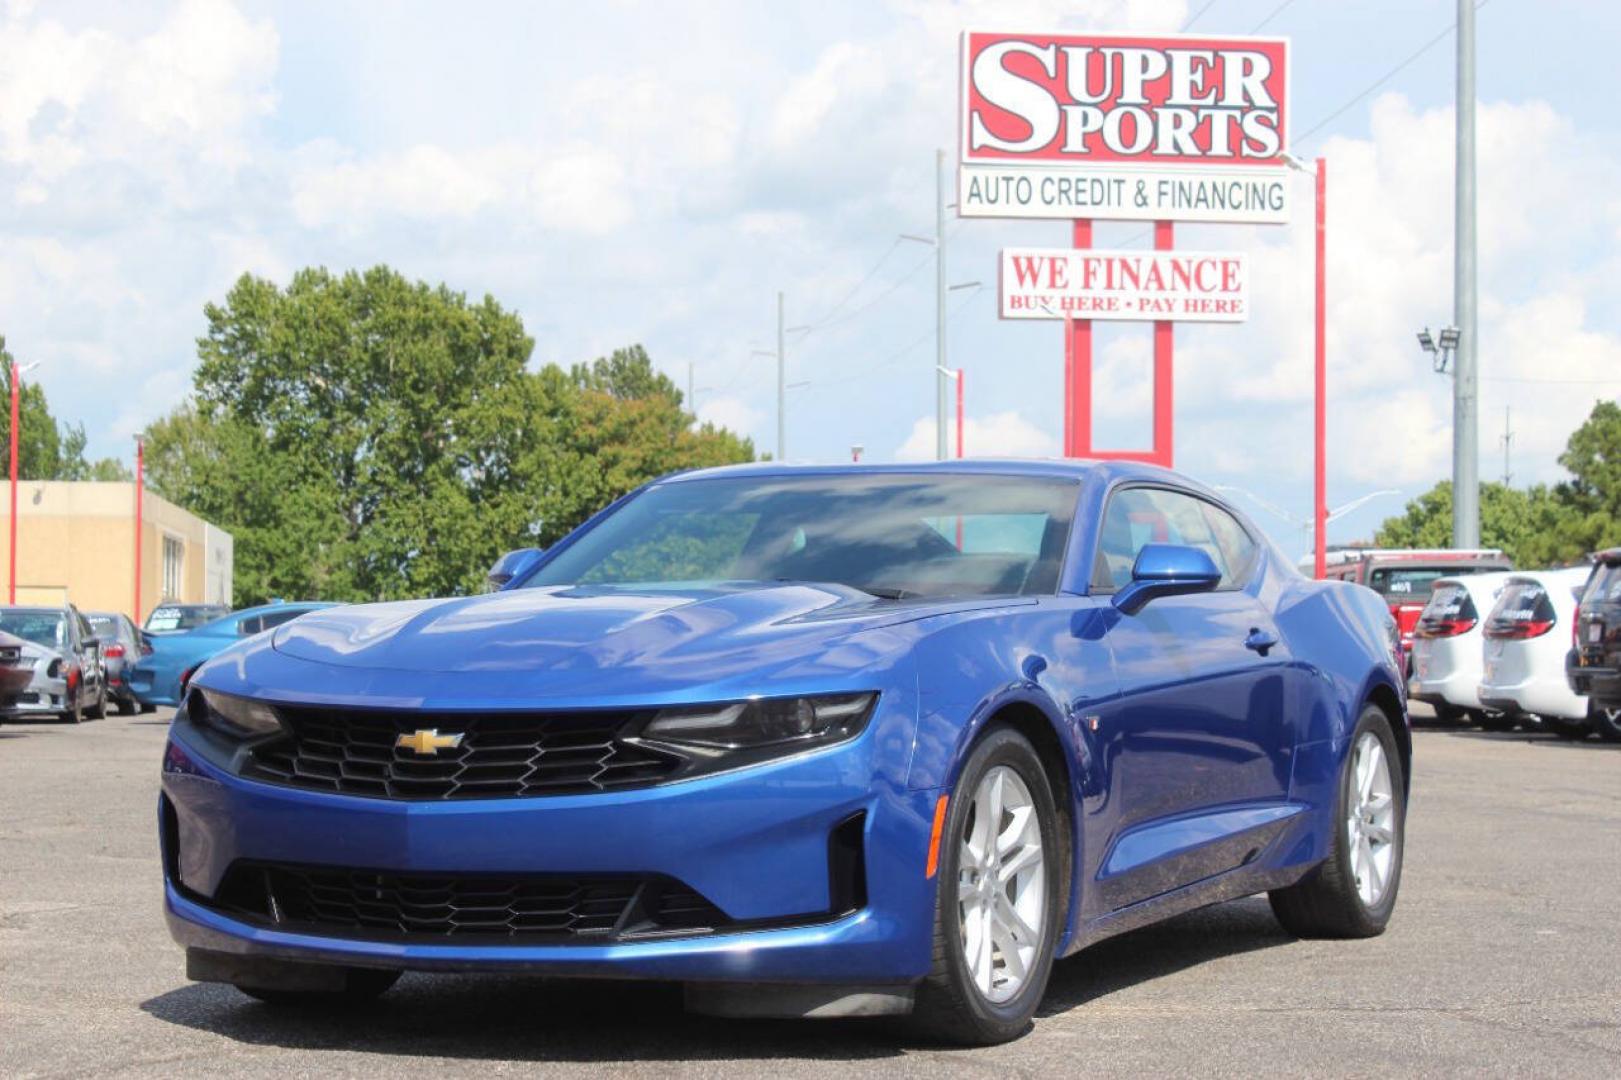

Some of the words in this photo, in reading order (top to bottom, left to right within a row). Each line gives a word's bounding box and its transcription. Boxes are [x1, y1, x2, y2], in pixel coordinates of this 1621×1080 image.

[972, 39, 1278, 153] SUPER
[967, 175, 1033, 205] AUTO
[1040, 177, 1126, 208] CREDIT
[1133, 179, 1149, 207] &
[1157, 179, 1285, 211] FINANCING
[1011, 256, 1069, 290] WE
[1082, 257, 1242, 293] FINANCE
[1009, 295, 1055, 310] BUY
[1060, 297, 1119, 312] HERE
[1138, 297, 1177, 313] PAY
[1183, 298, 1243, 314] HERE
